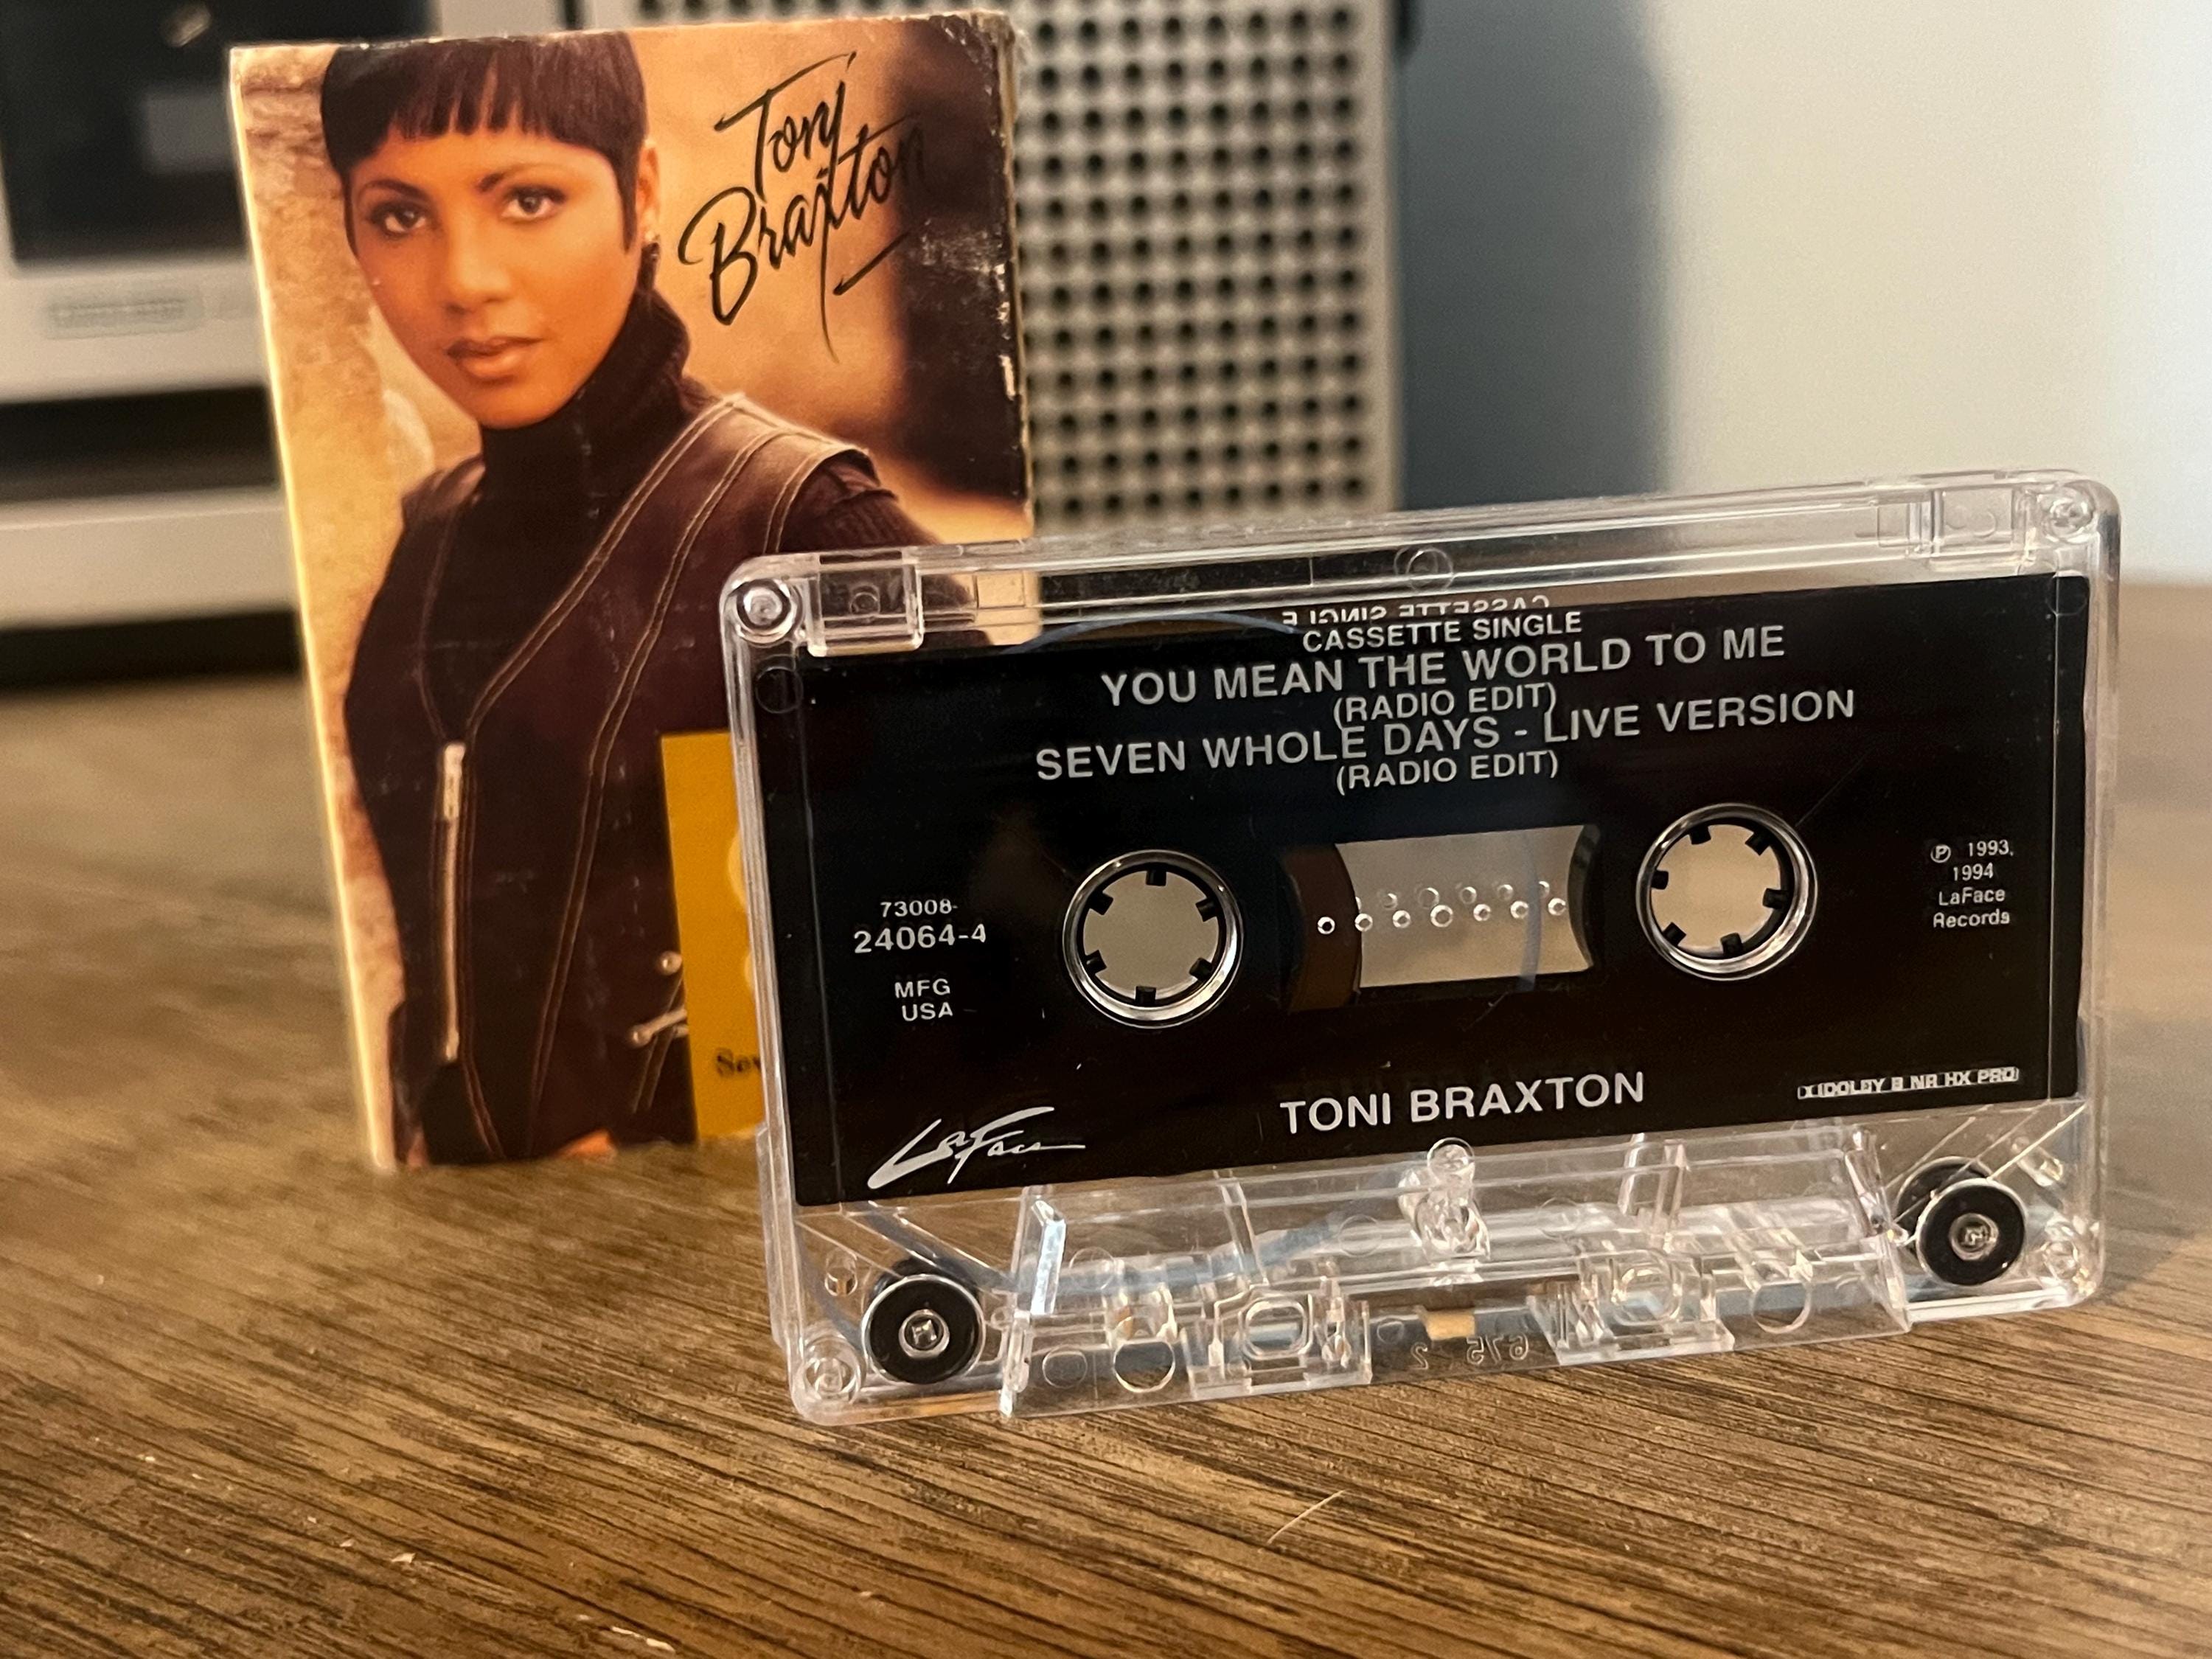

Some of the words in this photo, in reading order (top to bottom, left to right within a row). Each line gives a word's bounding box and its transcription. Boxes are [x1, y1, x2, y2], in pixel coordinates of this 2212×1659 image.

[678, 112, 932, 363] Braxton
[1303, 620, 1461, 653] CASSETTE
[1472, 611, 1582, 641] SINGLE
[1101, 670, 1196, 706] YOU
[1214, 659, 1343, 700] MEAN
[1357, 652, 1447, 689] THE
[1461, 638, 1631, 681] WORLD
[1645, 631, 1706, 666] TO
[1723, 625, 1785, 660] ME
[1333, 689, 1455, 728] (RADIO
[1468, 683, 1557, 715] EDIT)
[1036, 740, 1186, 780] SEVEN
[1202, 727, 1367, 768] WHOLE
[1384, 716, 1500, 755] DAYS
[1545, 705, 1640, 742] LIVE
[1656, 689, 1854, 732] VERSION
[1336, 757, 1457, 796] (RADIO
[1470, 749, 1558, 779] EDIT)
[1953, 862, 1994, 881] 1994
[1938, 886, 2006, 906] LaFace
[1933, 908, 2011, 928] Records
[854, 923, 987, 953] 24064-4
[894, 978, 950, 998] MFG
[901, 1001, 953, 1022] USA
[1945, 1071, 1972, 1087] HX
[1279, 1092, 1391, 1134] TONI
[1410, 1071, 1644, 1123] BRAXTON
